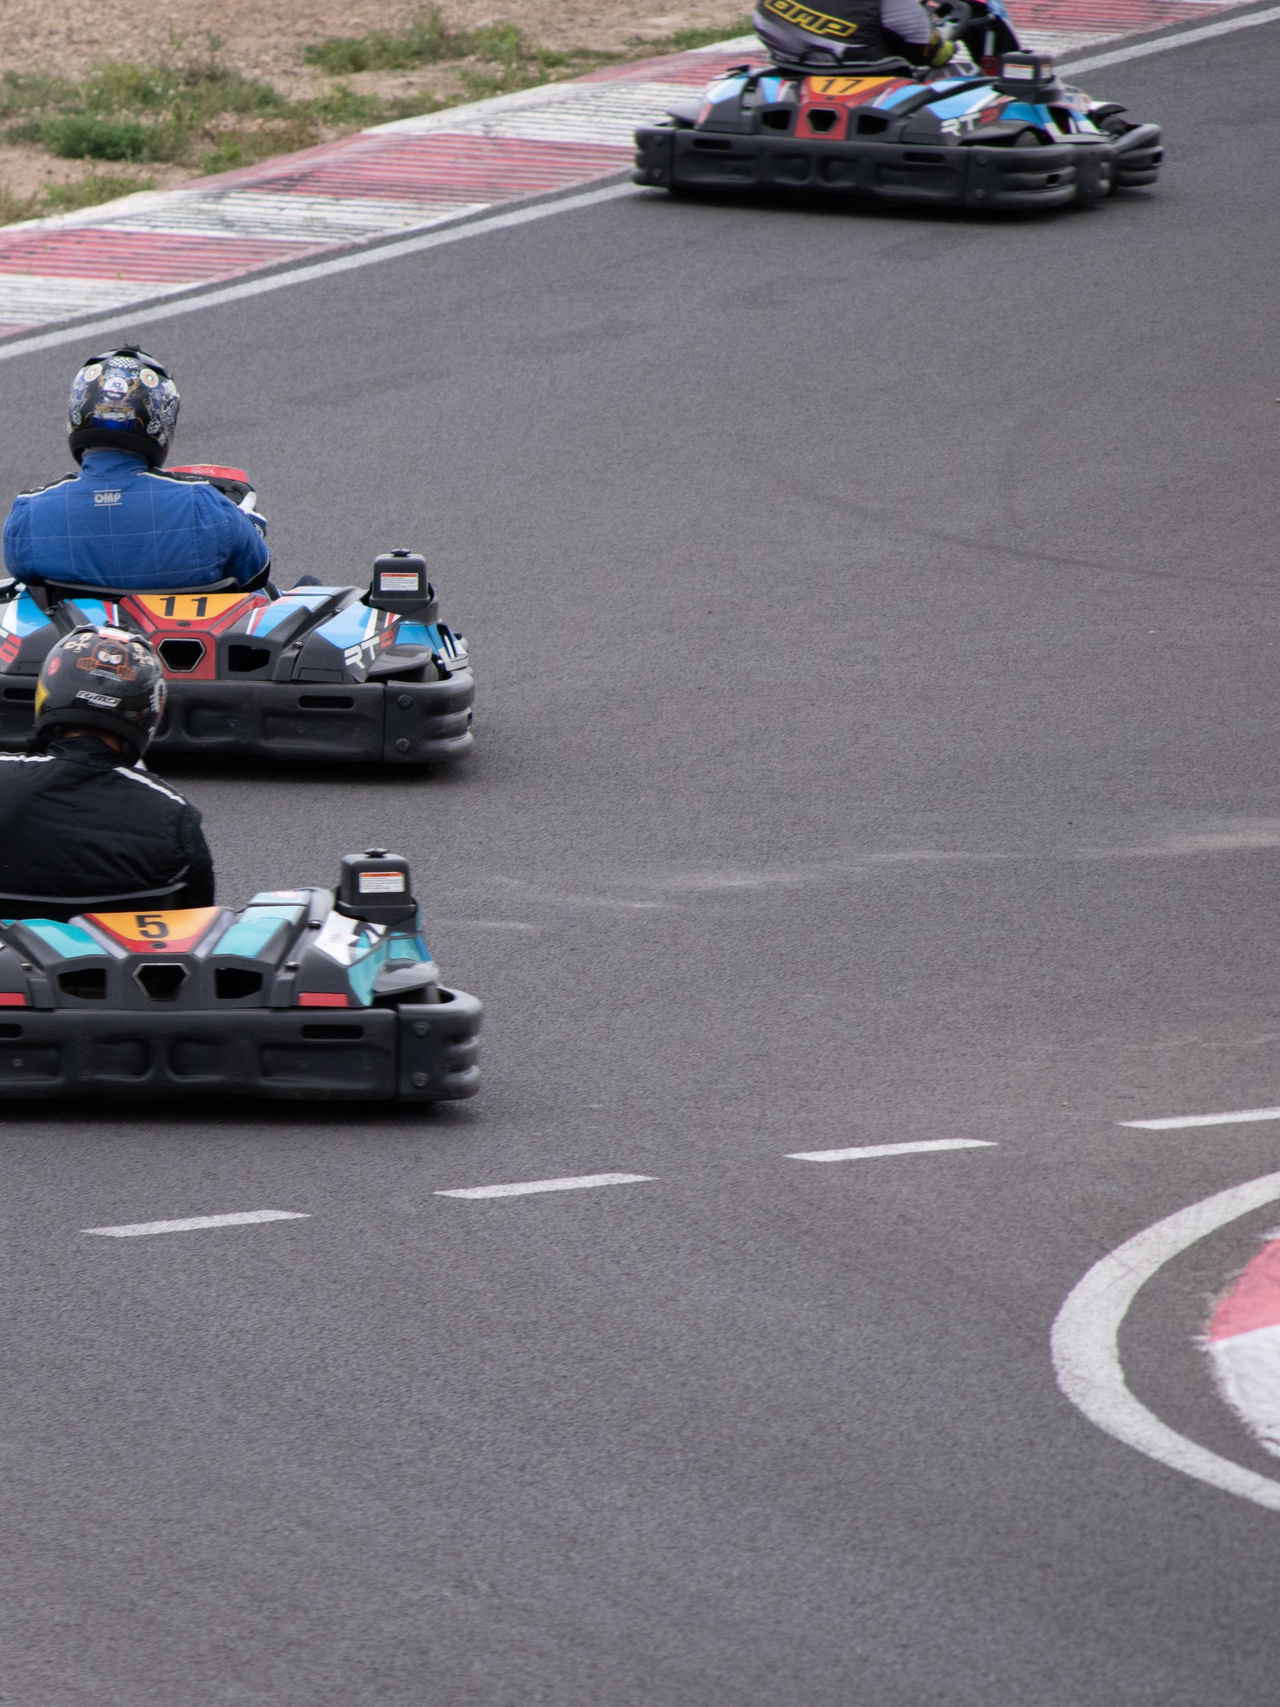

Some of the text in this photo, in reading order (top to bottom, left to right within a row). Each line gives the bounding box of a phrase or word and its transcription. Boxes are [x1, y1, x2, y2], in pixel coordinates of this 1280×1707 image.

[819, 79, 863, 94] 17
[94, 492, 122, 504] OMP
[159, 596, 208, 617] 11
[135, 914, 169, 939] 5
